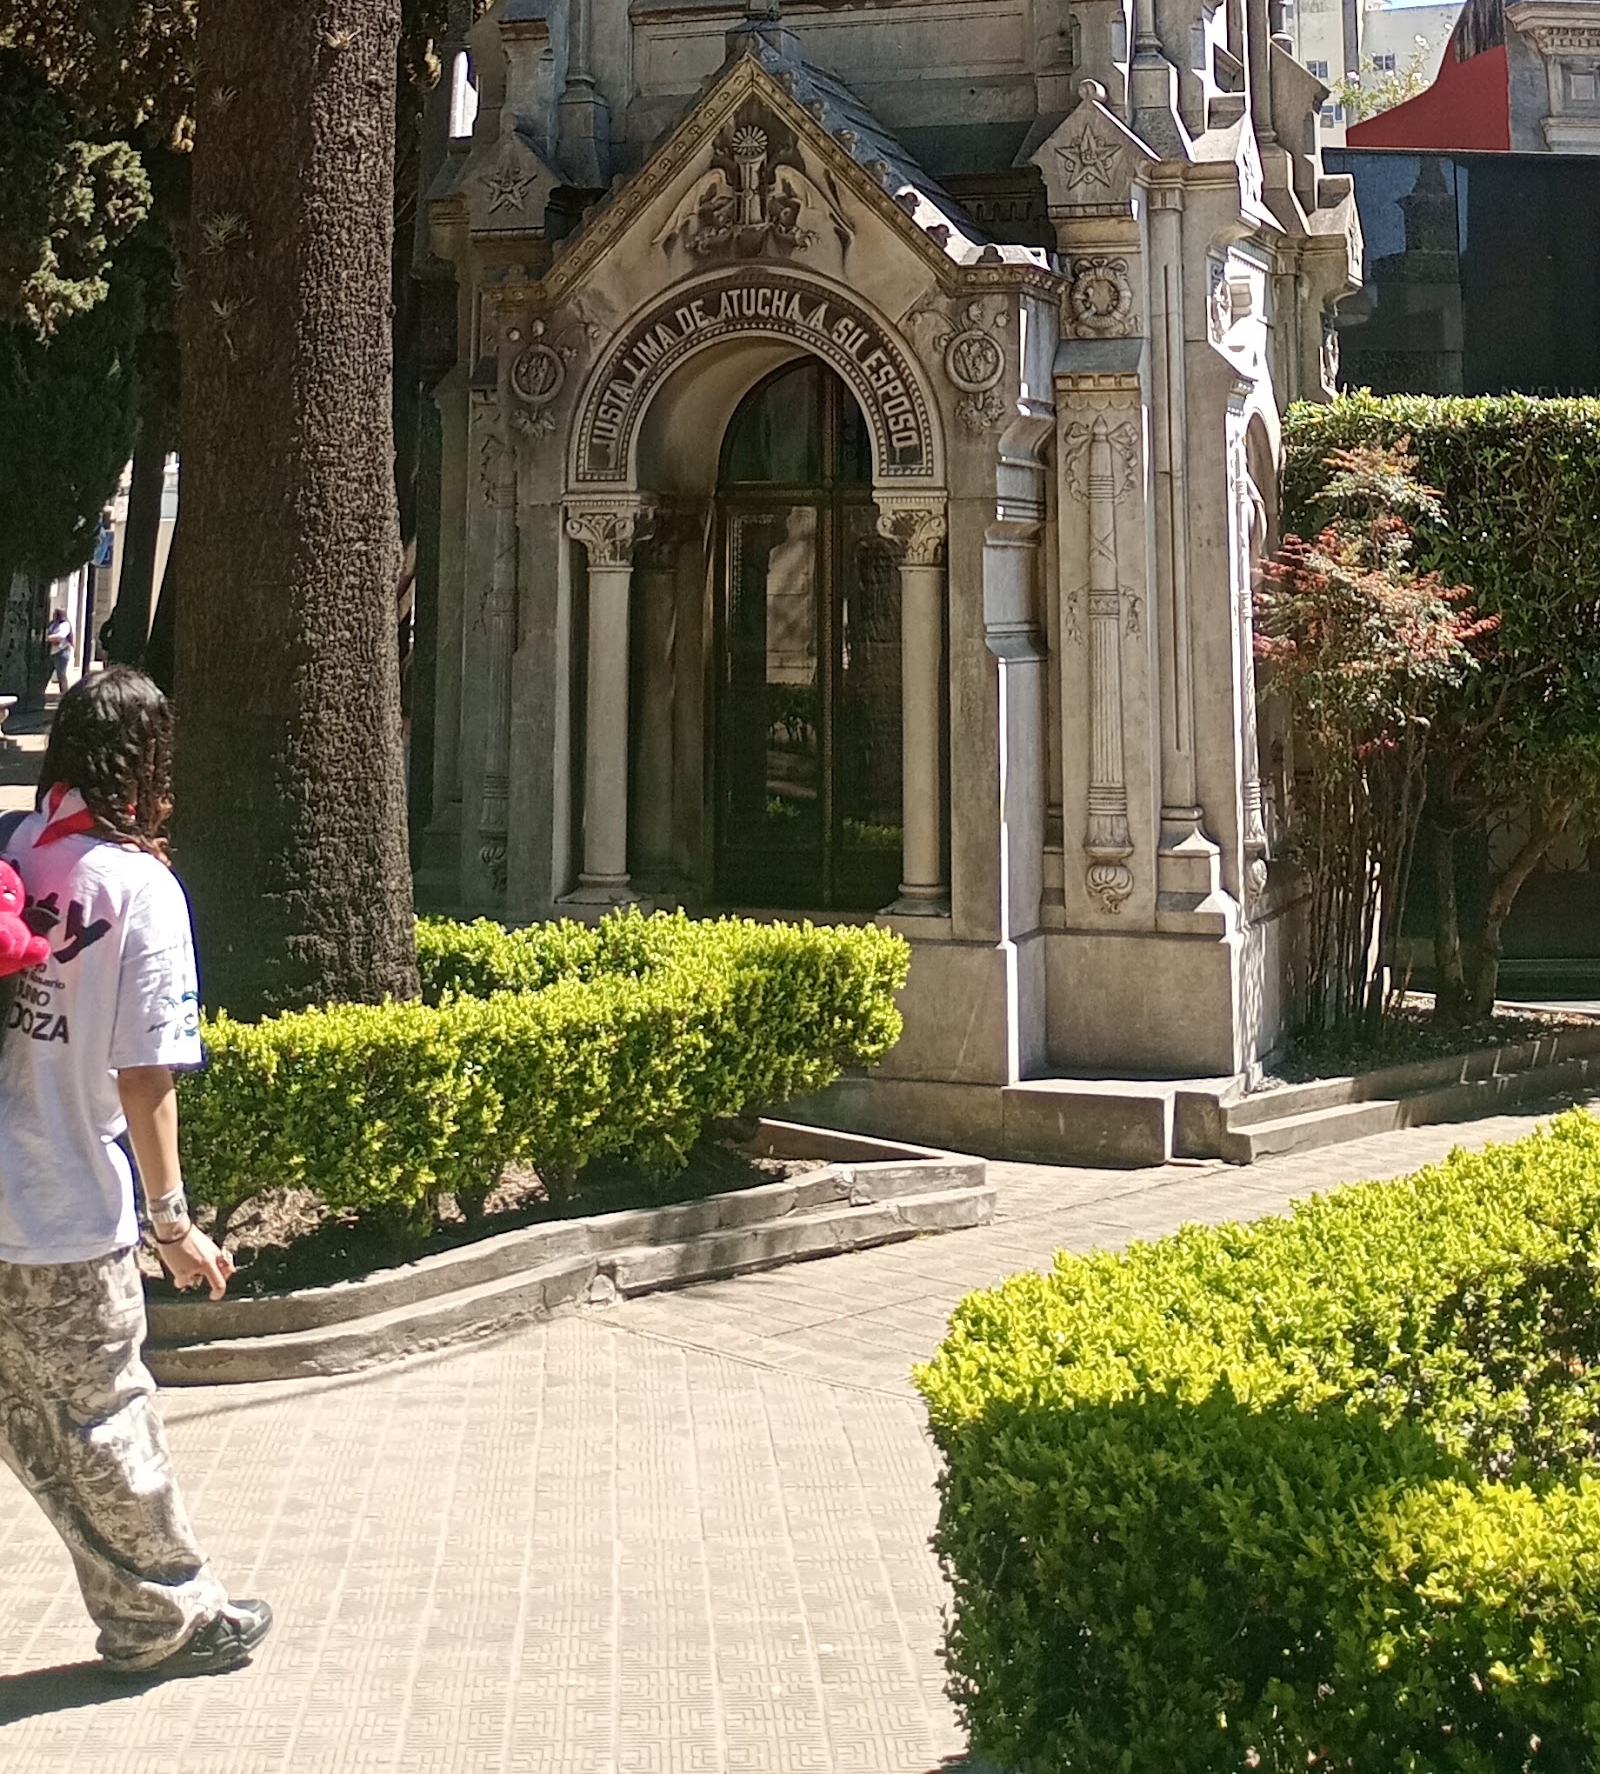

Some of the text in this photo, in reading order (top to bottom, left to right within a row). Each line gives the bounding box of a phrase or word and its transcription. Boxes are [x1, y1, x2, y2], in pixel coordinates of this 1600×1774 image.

[591, 288, 919, 448] JUSTA LIMA DE ATUCHA A SU ESPOSO
